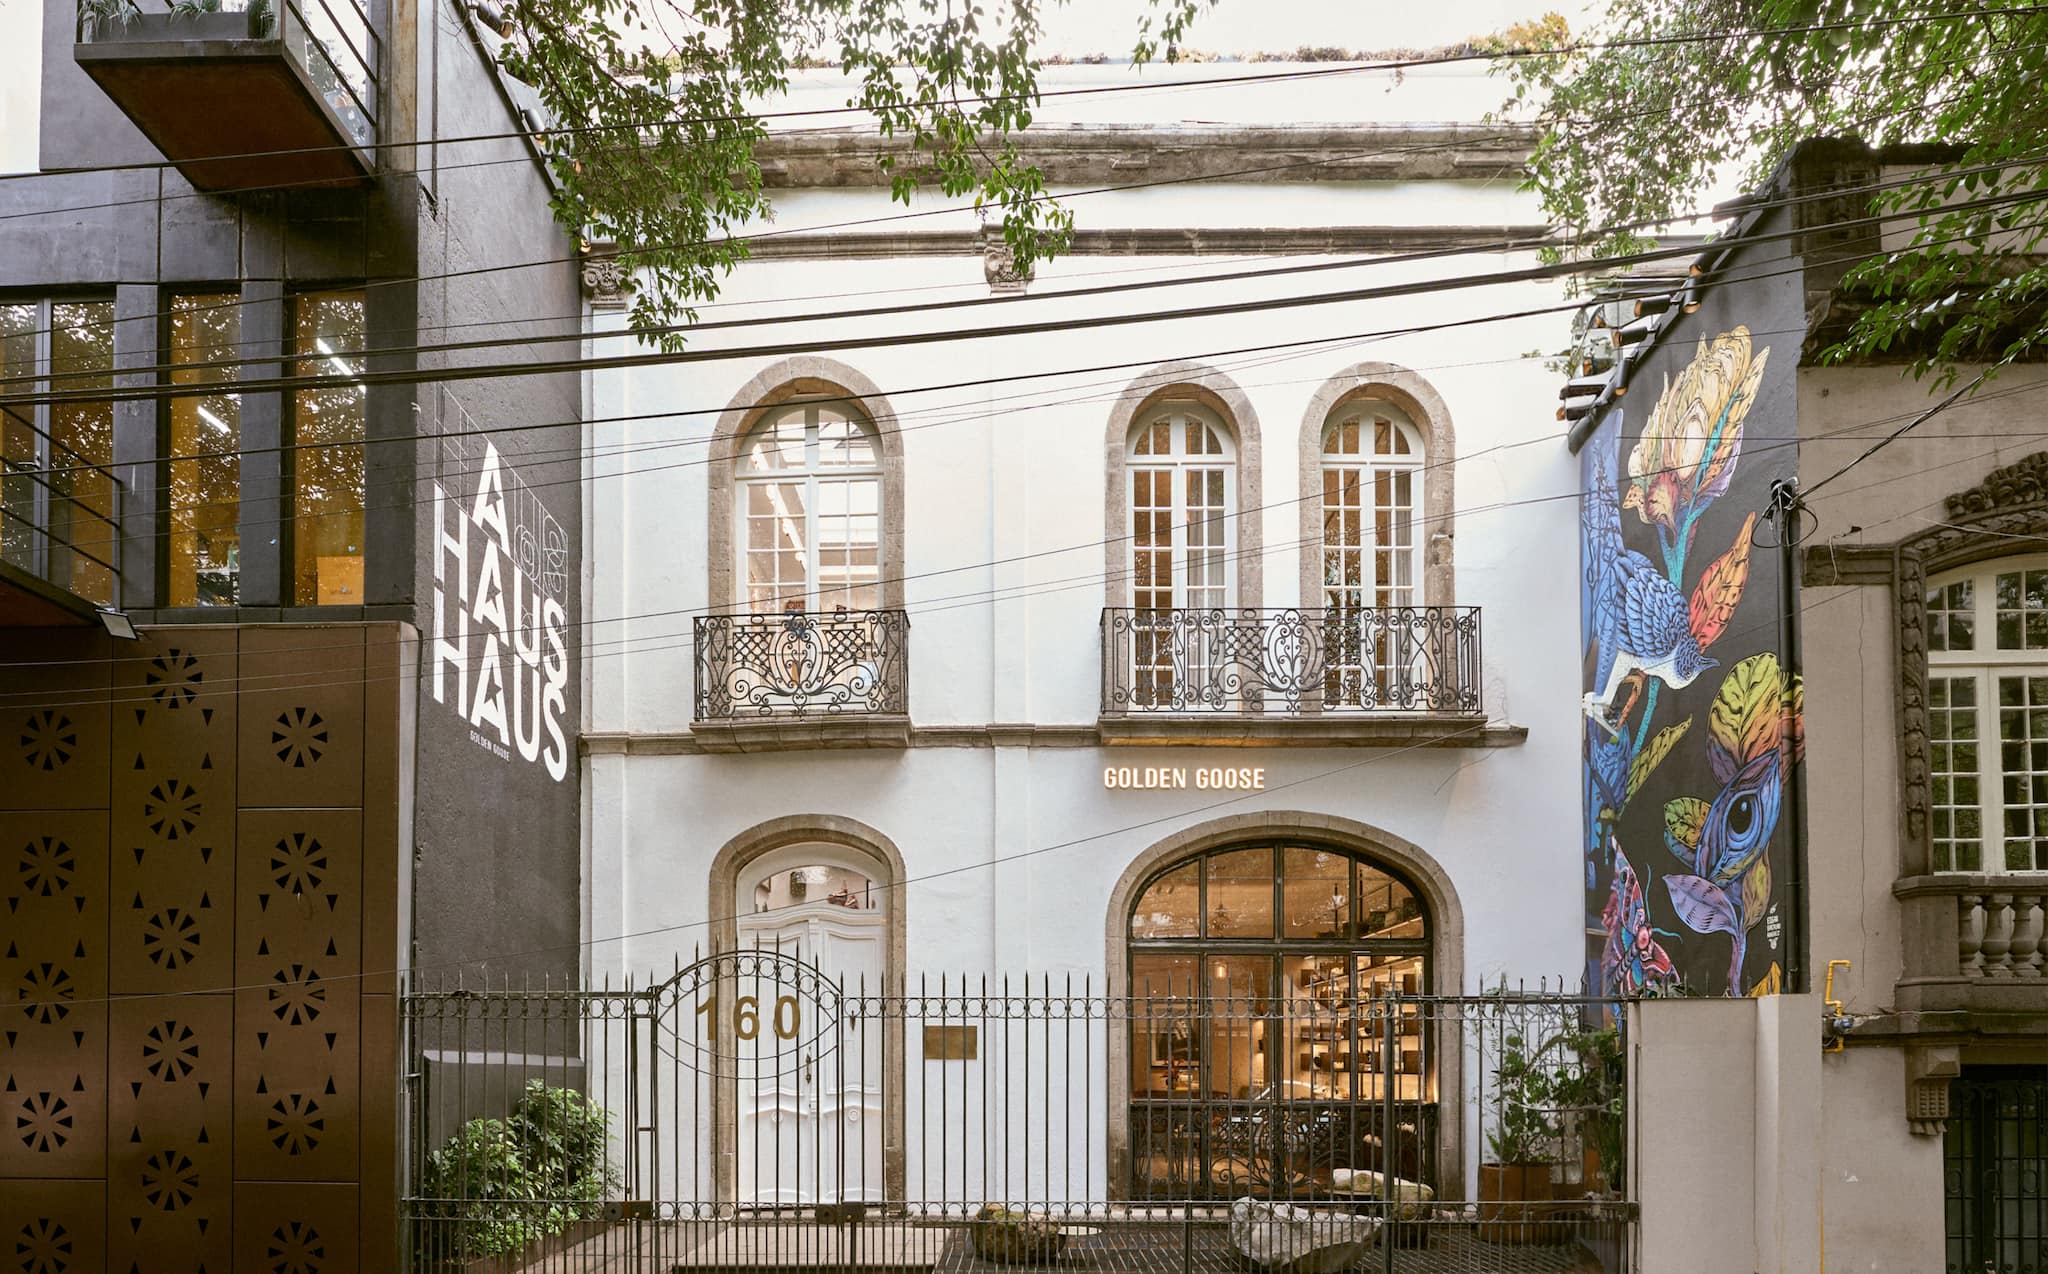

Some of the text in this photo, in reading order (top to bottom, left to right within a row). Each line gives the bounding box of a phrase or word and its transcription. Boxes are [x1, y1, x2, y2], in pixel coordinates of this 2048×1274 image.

[434, 482, 568, 690] HAUS
[434, 583, 568, 782] HAUS
[1104, 767, 1265, 789] GOLDEN GOOSE
[697, 995, 800, 1041] 160
